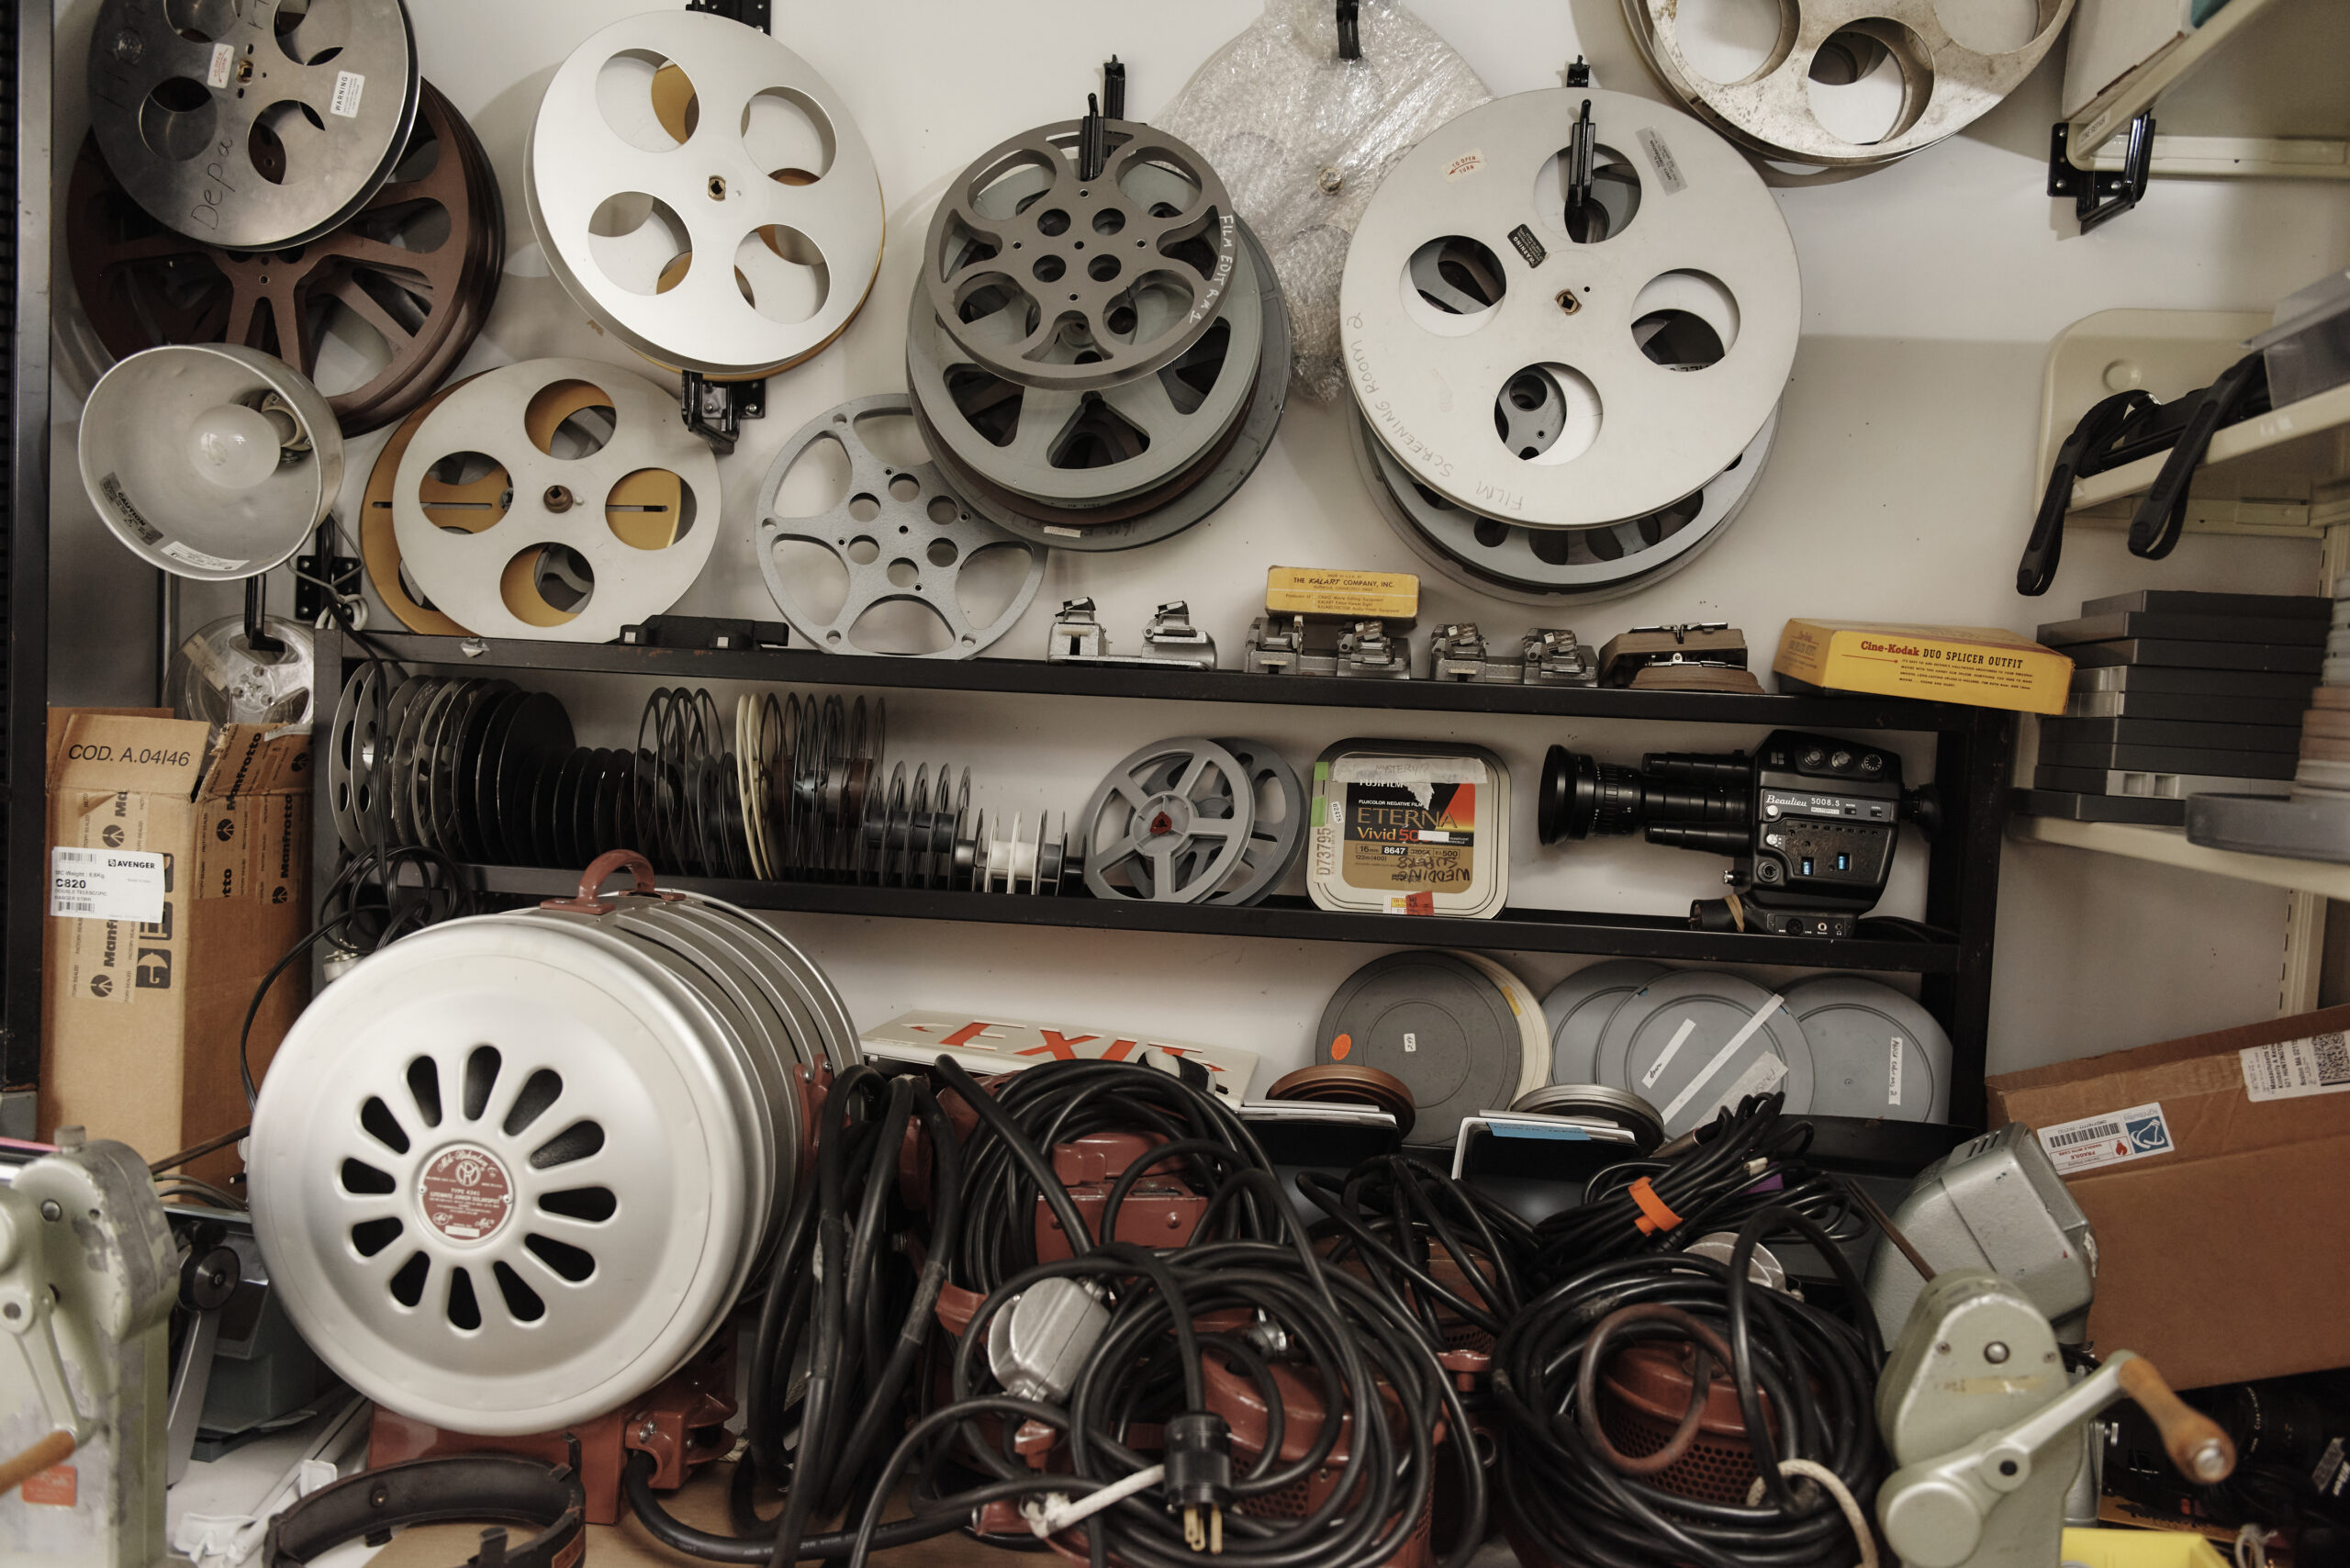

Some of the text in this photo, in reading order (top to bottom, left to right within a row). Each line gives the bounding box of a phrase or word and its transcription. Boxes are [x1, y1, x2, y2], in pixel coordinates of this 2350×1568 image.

[334, 76, 348, 111] WARNING
[1459, 165, 1474, 174] TURN
[1219, 215, 1234, 248] FILM
[1214, 254, 1234, 286] EDIT
[1350, 340, 1380, 395] ROOM
[1375, 400, 1454, 477] SCREENING
[1475, 480, 1524, 510] FILM
[118, 491, 146, 526] CAUTION
[1343, 579, 1379, 588] COMPANY,
[1860, 640, 2023, 669] Cine-Kodak DUO SPLICER OUTFIT
[68, 744, 114, 762] COD.
[226, 733, 262, 811] Manfrotto
[1360, 779, 1404, 789] FUJIFILM
[1765, 794, 1807, 808] Beaulieu
[1810, 797, 1841, 807] 5008.S
[1358, 807, 1459, 829] ETERNA
[280, 794, 293, 879] Manfrotto
[1356, 826, 1396, 842] Vivid
[1316, 827, 1332, 876] D73795
[1383, 846, 1406, 855] 8647
[118, 860, 155, 869] AVENGER
[55, 878, 87, 890] C820
[938, 1020, 1203, 1061] EXIT
[2263, 1051, 2276, 1090] Massachusetts
[2295, 1056, 2302, 1067] MA
[2275, 1065, 2284, 1089] Kimberly
[2298, 1067, 2307, 1086] Boston
[2070, 1150, 2096, 1160] FRAGILE
